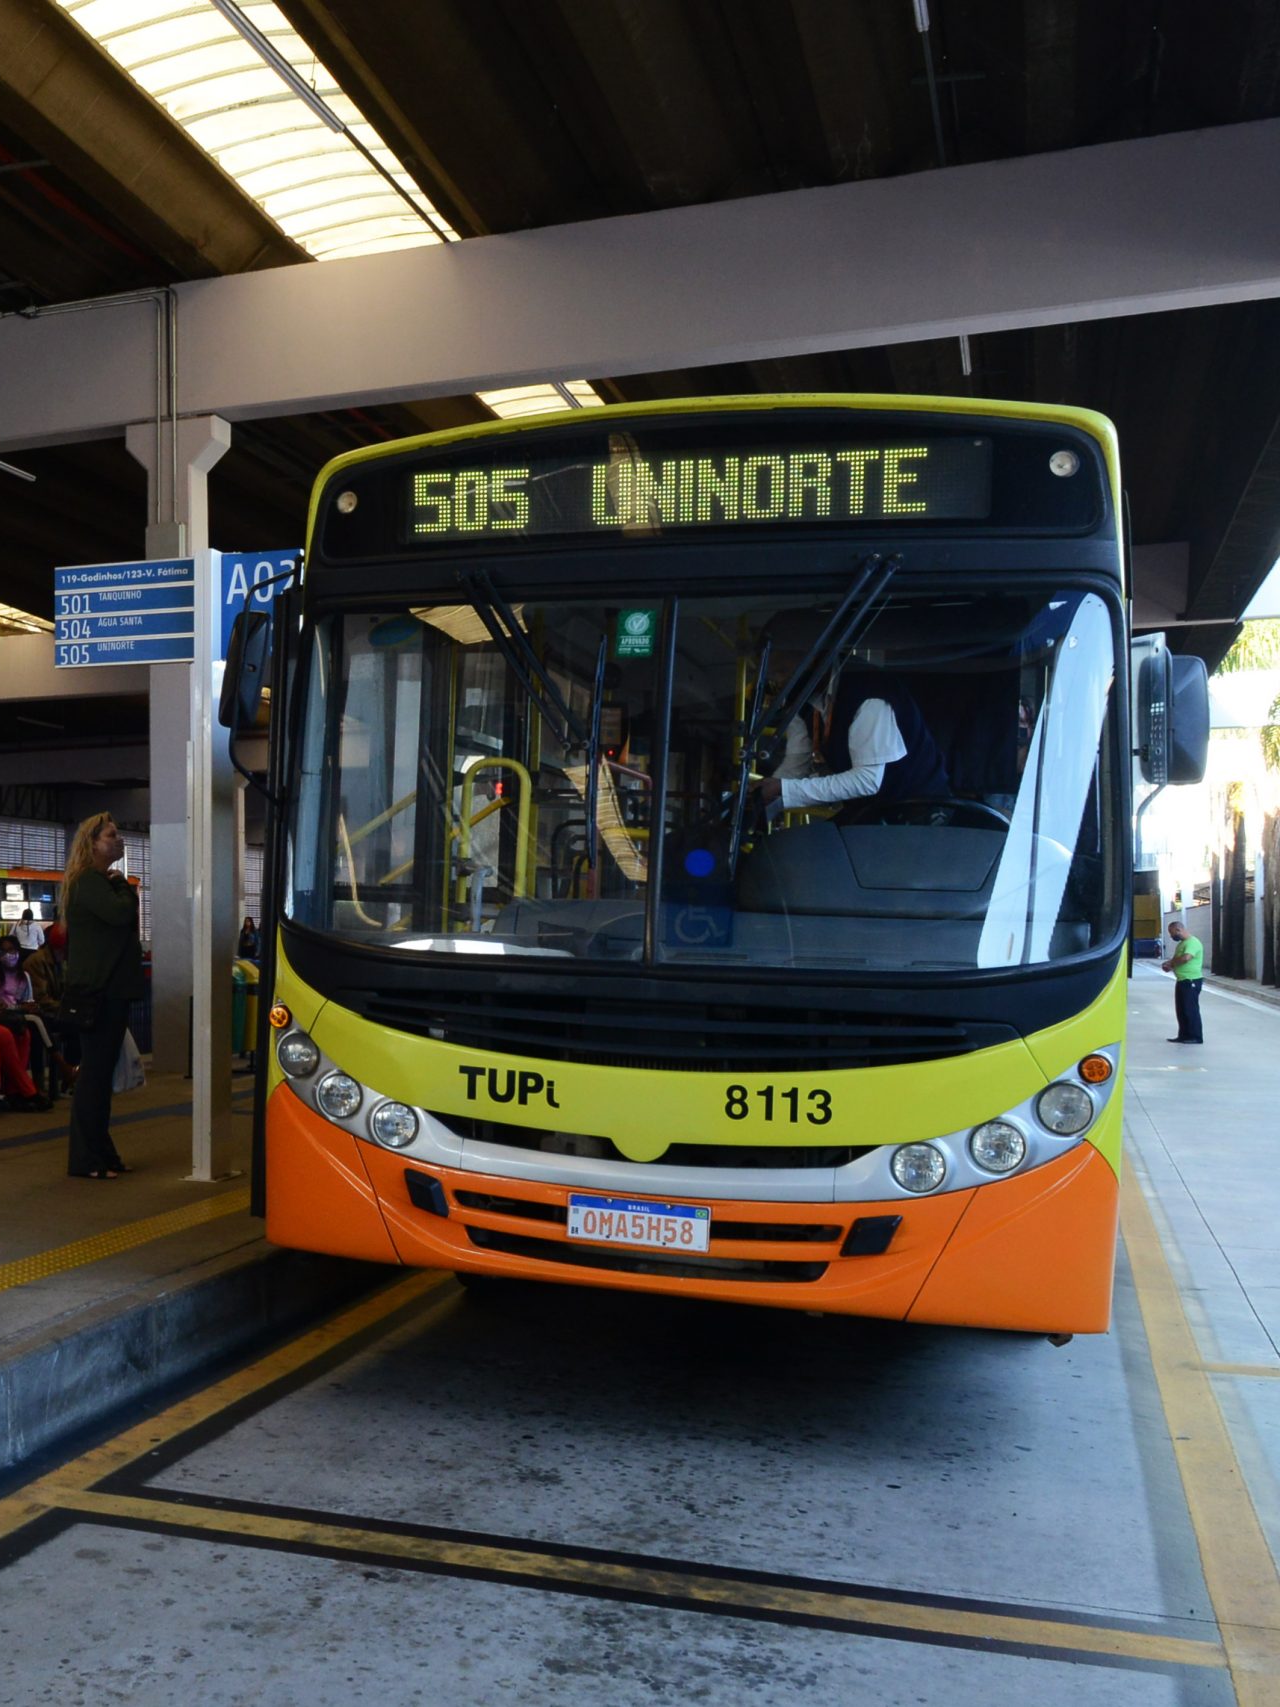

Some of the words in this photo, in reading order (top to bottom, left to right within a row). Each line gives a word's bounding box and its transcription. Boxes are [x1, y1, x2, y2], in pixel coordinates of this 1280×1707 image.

[413, 468, 530, 533] 505
[591, 446, 929, 527] UNINORTE
[157, 567, 189, 577] Fátima
[61, 594, 91, 615] 501
[98, 590, 142, 601] TANQUINHO
[60, 619, 91, 640] 504
[97, 616, 118, 627] ÁGUA
[120, 616, 143, 626] SANTA
[60, 644, 90, 665] 505
[97, 641, 135, 651] UNINORTE
[724, 1084, 833, 1125] 8113
[627, 1204, 651, 1212] BRASIL
[583, 1209, 694, 1245] OMA5H58
